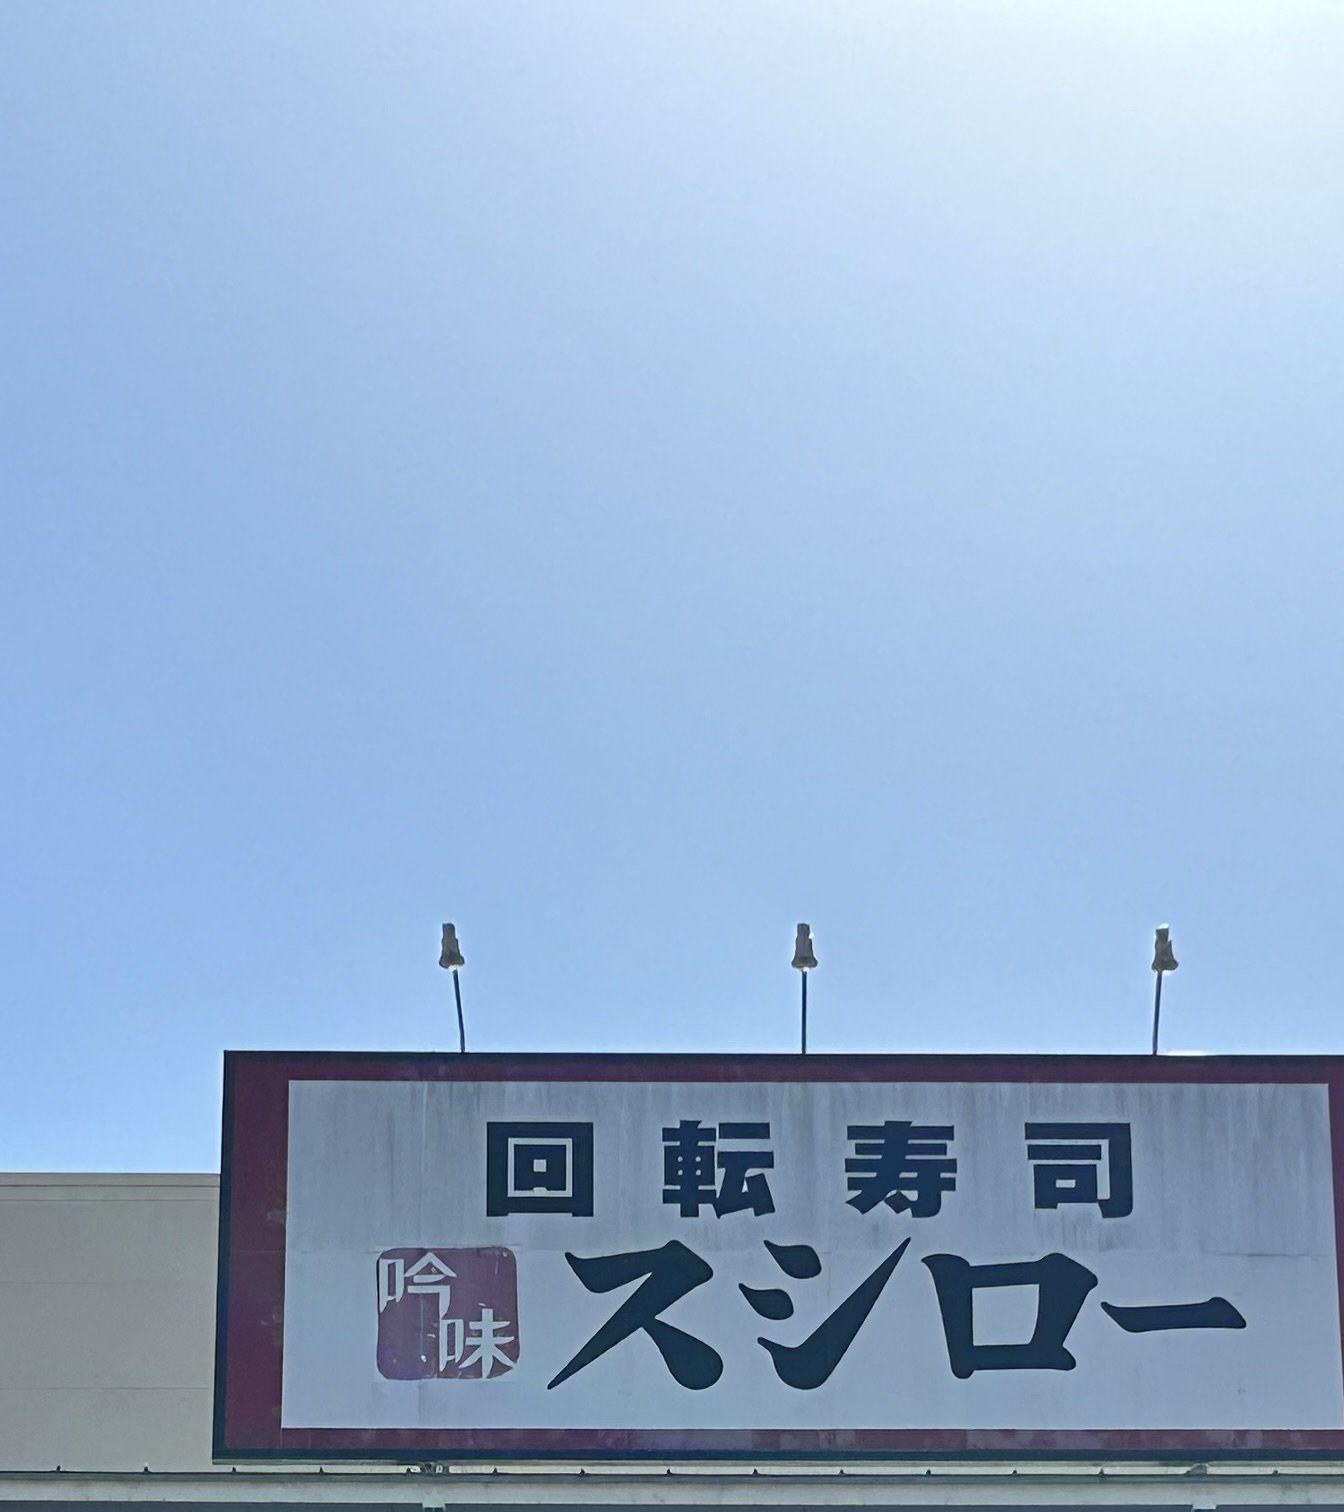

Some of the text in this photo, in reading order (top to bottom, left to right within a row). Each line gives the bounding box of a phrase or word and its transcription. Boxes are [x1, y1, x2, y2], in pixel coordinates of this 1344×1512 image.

[485, 1120, 1135, 1219] 回転寿司
[376, 1236, 1247, 1391] 吟味 スシロー
